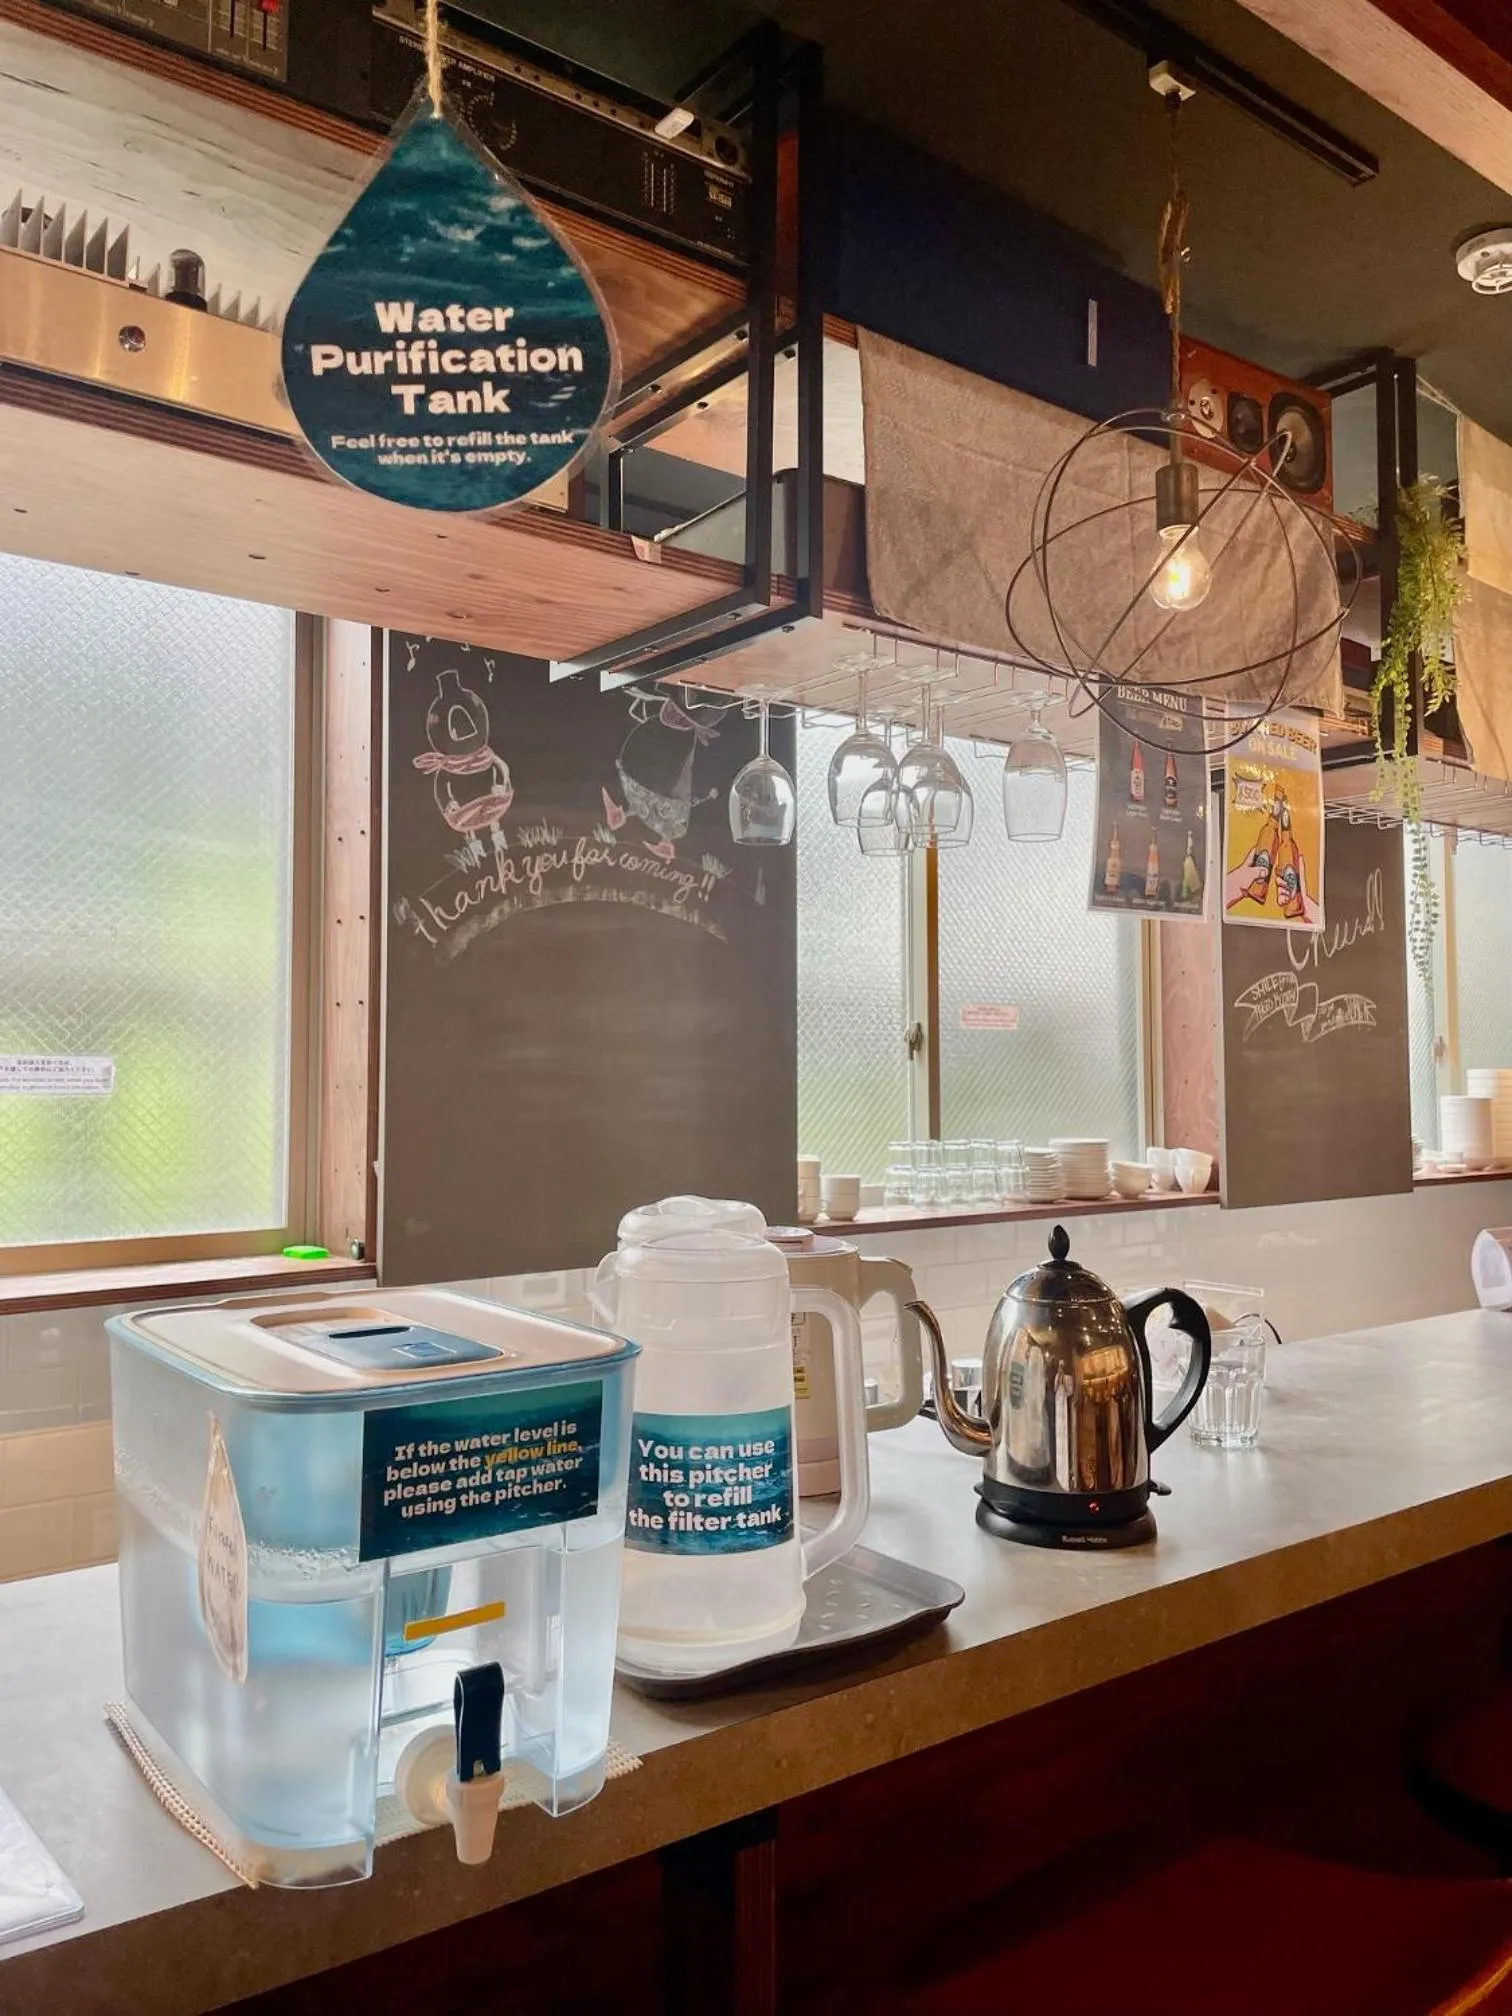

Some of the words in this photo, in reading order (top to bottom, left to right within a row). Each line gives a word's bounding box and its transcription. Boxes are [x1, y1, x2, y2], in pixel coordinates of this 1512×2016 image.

[374, 301, 514, 334] Water
[310, 337, 584, 376] Purification
[391, 380, 511, 415] Tank
[331, 433, 376, 450] Feel
[378, 433, 420, 449] free
[423, 434, 444, 449] to
[448, 431, 492, 448] refill
[495, 430, 527, 446] the
[530, 429, 575, 445] tank
[377, 451, 429, 466] when
[430, 450, 461, 465] it's
[464, 450, 532, 467] empty.
[1152, 690, 1187, 713] MENU
[1267, 740, 1298, 761] SALE
[521, 853, 577, 895] you
[569, 836, 617, 882] for
[394, 1443, 415, 1461] If
[418, 1440, 451, 1456] the
[454, 1432, 511, 1452] water
[513, 1421, 559, 1443] level
[561, 1420, 578, 1436] is
[637, 1439, 683, 1460] You
[687, 1443, 734, 1460] can
[738, 1439, 776, 1458] use
[386, 1461, 446, 1482] below
[449, 1454, 481, 1472] the
[483, 1445, 543, 1470] yellow
[639, 1463, 684, 1484] this
[688, 1462, 774, 1490] pitcher
[383, 1480, 452, 1506] please
[456, 1471, 492, 1489] add
[495, 1466, 528, 1483] tap
[531, 1455, 584, 1477] water
[401, 1495, 457, 1519] using
[460, 1489, 492, 1508] the
[495, 1477, 567, 1505] pitcher.
[662, 1489, 690, 1508] to
[694, 1485, 752, 1508] refill
[628, 1507, 664, 1529] the
[667, 1508, 732, 1532] filter
[735, 1503, 783, 1529] tank
